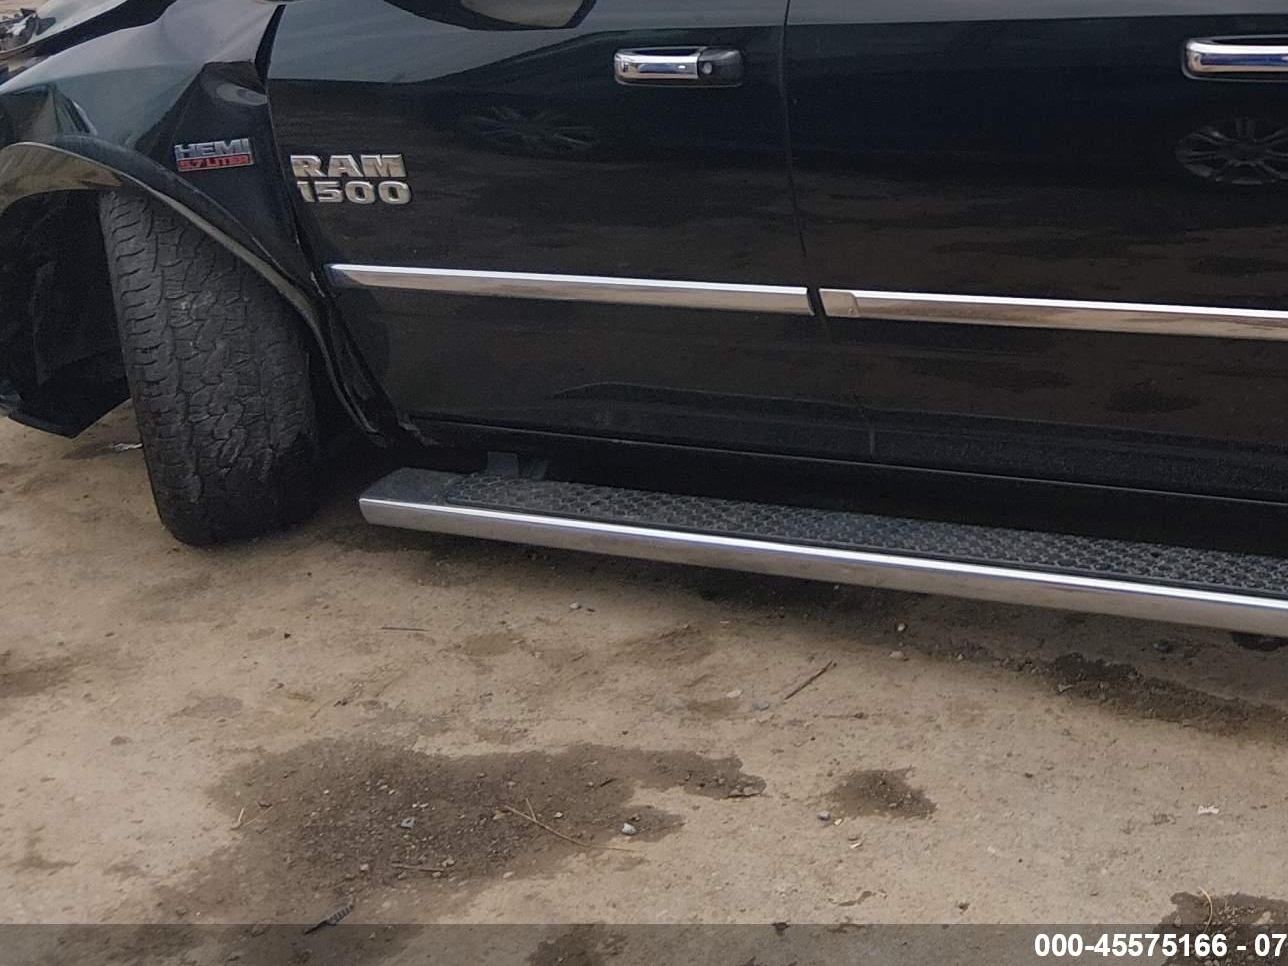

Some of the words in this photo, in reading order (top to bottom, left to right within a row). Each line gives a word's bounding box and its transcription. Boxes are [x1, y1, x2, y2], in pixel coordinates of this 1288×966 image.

[174, 138, 250, 159] HEMI
[290, 153, 407, 178] RAM
[296, 180, 411, 205] 1500
